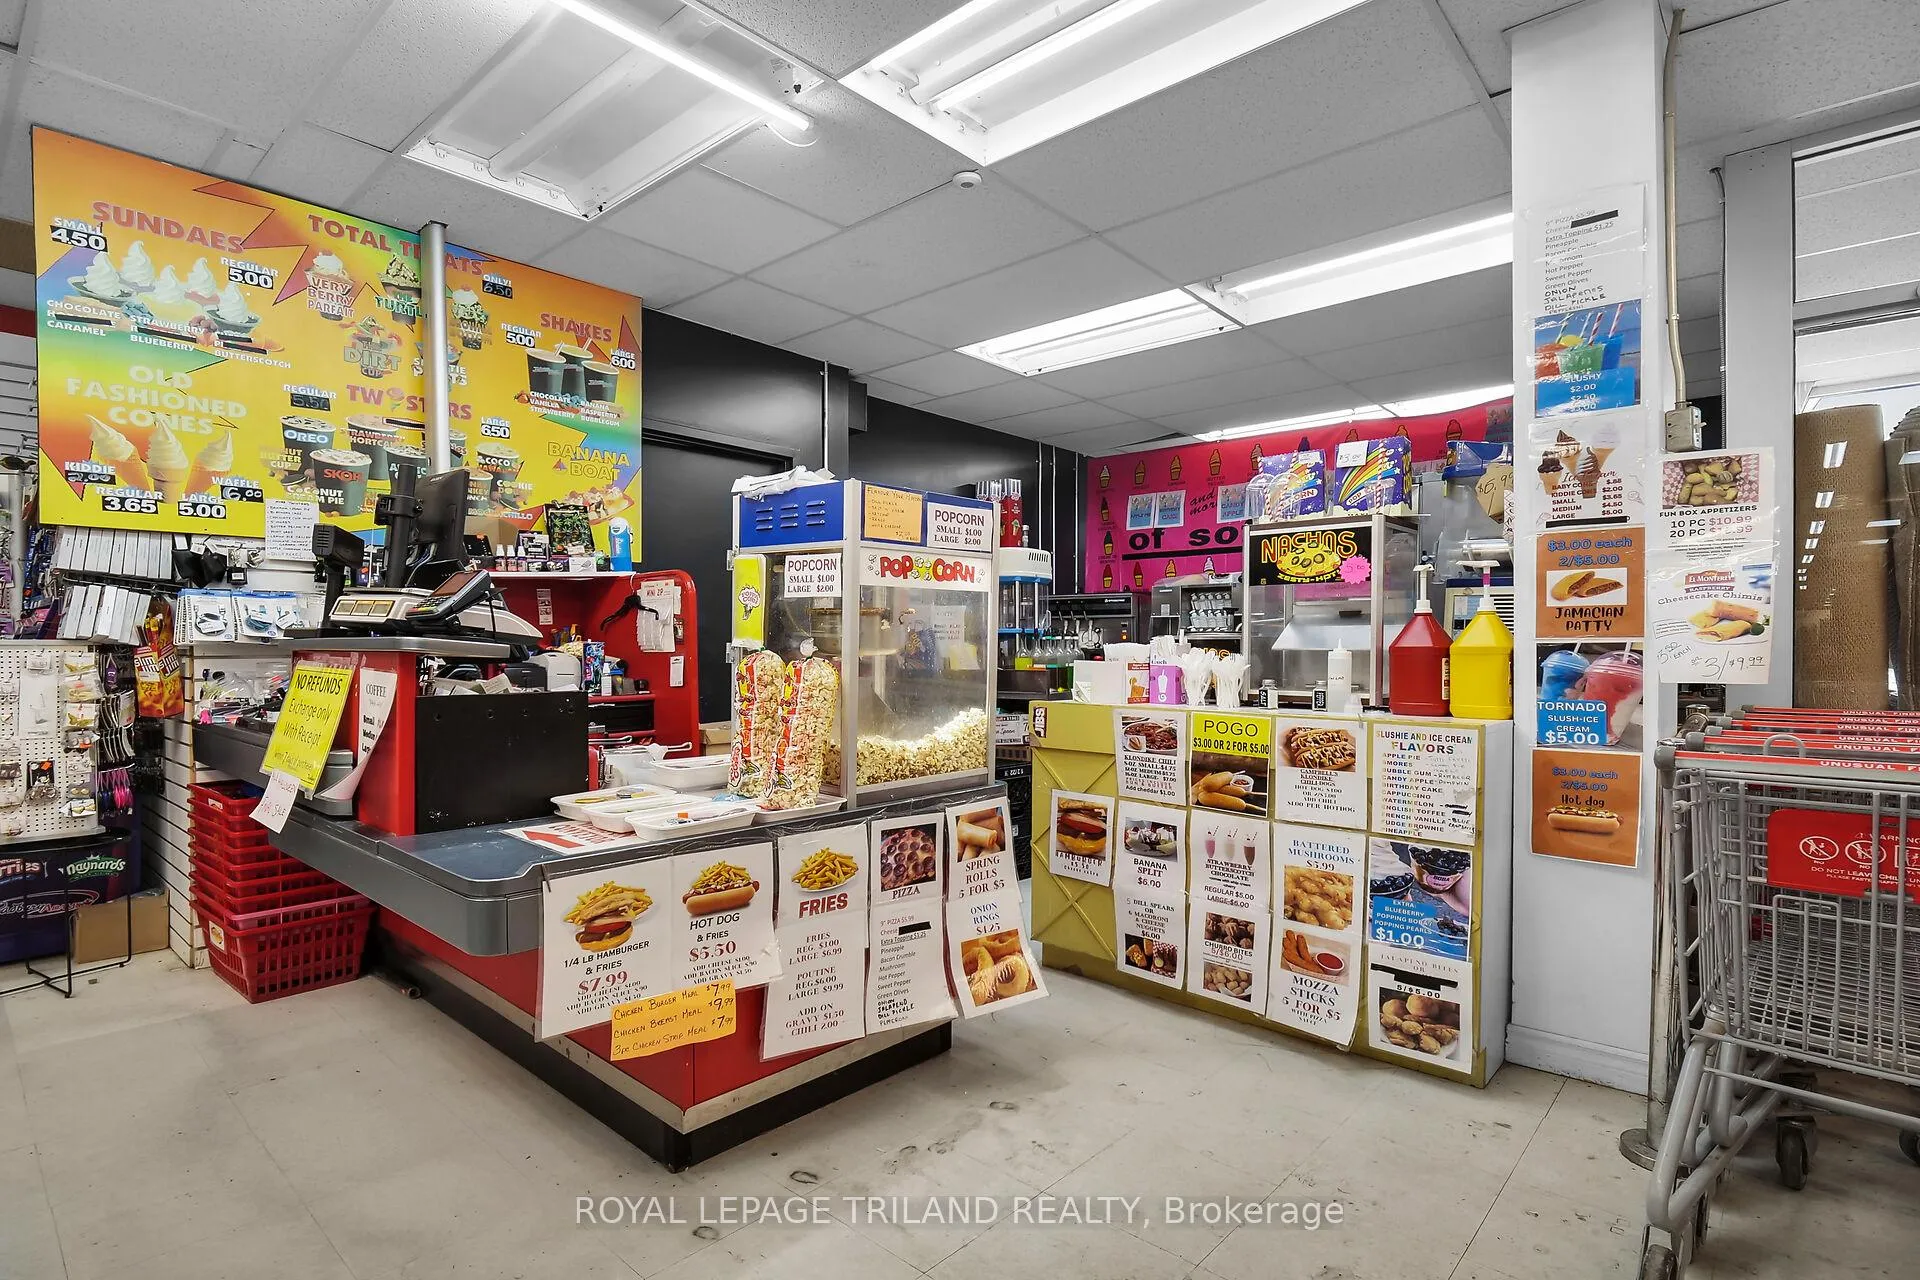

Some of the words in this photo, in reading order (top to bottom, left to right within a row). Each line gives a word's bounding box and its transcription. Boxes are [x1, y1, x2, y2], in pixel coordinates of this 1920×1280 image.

[92, 201, 244, 254] SUNDAES
[308, 214, 392, 251] TOTAL
[51, 228, 107, 251] 4.50
[221, 257, 278, 277] REGULAR
[312, 277, 352, 294] VERY
[1544, 286, 1577, 297] ONION
[308, 287, 354, 306] BERRY
[47, 299, 121, 320] CHOCOLATE
[47, 320, 106, 336] CARAMEL
[130, 314, 206, 334] STRAWBERRY
[540, 313, 612, 342] SHAKES
[130, 334, 194, 352] BLUEBERRY
[214, 349, 291, 369] BUTTERSCOTCH
[344, 346, 401, 371] DIRT
[129, 365, 193, 389] OLD
[1565, 373, 1602, 384] SLUSHY
[66, 378, 247, 418] FASHIONED
[283, 384, 336, 399] REGULAR
[108, 406, 213, 435] CONES
[480, 416, 511, 427] LARGE
[284, 429, 329, 444] OREO
[547, 441, 630, 467] BANANA
[64, 461, 116, 475] KIDDIE
[570, 461, 620, 481] BOAT
[212, 476, 260, 489] WAFFLE
[96, 485, 163, 500] REGULAR
[104, 497, 157, 513] 3.65
[179, 503, 226, 518] 5.00
[1601, 508, 1623, 516] $5.00
[1659, 508, 1677, 518] FUN
[1679, 508, 1698, 516] BOX
[1700, 504, 1758, 515] APPETIZERS
[934, 509, 985, 527] POPCORN
[1671, 519, 1686, 528] 10
[1688, 518, 1706, 527] PC
[1708, 515, 1753, 526] $10.99
[936, 525, 963, 535] SMALL
[965, 527, 983, 537] $1.00
[1128, 527, 1164, 550] of
[1669, 529, 1686, 538] 20
[1688, 527, 1706, 537] PC
[934, 534, 960, 543] LARGE
[964, 537, 981, 546] $2.00
[1261, 531, 1357, 563] NACHOS
[1547, 538, 1591, 552] $3.00
[1595, 537, 1632, 549] each
[787, 557, 837, 572] POPCORN
[1559, 553, 1620, 567] 2/$5.00
[879, 554, 915, 579] POP
[931, 557, 975, 583] CORN
[788, 574, 814, 583] SMALL
[817, 573, 835, 583] $1.00
[787, 584, 811, 593] LARGE
[816, 584, 834, 593] $2.00
[1658, 592, 1720, 605] Cheesecake
[1722, 592, 1763, 602] Chimis
[1555, 607, 1624, 619] JAMACIAN
[1565, 619, 1613, 632] PATTY
[134, 655, 157, 668] slim
[159, 655, 178, 670] slim
[295, 673, 306, 689] NO
[307, 675, 343, 696] REFUNDS
[365, 683, 387, 698] COFFEE
[288, 698, 318, 718] Exchange
[316, 706, 331, 724] only
[1537, 701, 1607, 712] TORNADO
[1547, 714, 1599, 723] SLUSH-ICE
[1204, 719, 1258, 737] POGO
[1556, 725, 1590, 733] CREAM
[298, 725, 321, 749] Receipt
[1545, 730, 1600, 745] $5.00
[1193, 737, 1212, 748] $3.00
[1213, 739, 1224, 750] OR
[1226, 740, 1231, 750] 2
[1232, 741, 1248, 752] FOR
[1249, 743, 1269, 755] $5.00
[1391, 741, 1454, 755] FLAVORS
[1833, 744, 1900, 752] UNUSUAL
[1820, 760, 1896, 770] UNUSUAL
[1137, 786, 1159, 794] cheddar
[1561, 794, 1582, 805] Hot
[1585, 795, 1605, 808] dog
[1293, 839, 1350, 854] BATTERED
[1288, 847, 1355, 864] MUSHROOMS
[965, 855, 1000, 872] SPRING
[1133, 858, 1168, 871] BANANA
[1205, 863, 1255, 877] BUTTERSCOTCH
[1207, 858, 1252, 871] STRAWBERRY
[1306, 859, 1335, 871] $5.99
[1826, 867, 1844, 875] NOT
[966, 868, 997, 884] ROLLS
[1137, 865, 1163, 878] SPLIT
[1210, 870, 1249, 882] CHOCOLATE
[958, 889, 965, 898] 5
[969, 882, 989, 895] FOR
[993, 879, 1005, 891] $5
[1137, 877, 1162, 888] $6.00
[892, 886, 920, 900] PIZZA
[1204, 885, 1234, 897] REGULAR
[1235, 889, 1255, 901] $5.00
[799, 892, 848, 919] FRIES
[970, 901, 997, 915] ONION
[1133, 899, 1149, 908] DILL
[1150, 901, 1175, 912] SPEARS
[1384, 905, 1425, 917] BLUEBERRY
[690, 918, 714, 931] HOT
[716, 912, 740, 925] DOG
[973, 913, 1000, 925] RINGS
[1376, 912, 1406, 922] POPPING
[696, 933, 704, 943] &
[706, 930, 729, 940] FRIES
[1375, 927, 1425, 948] $1.00
[563, 957, 580, 969] 1/4
[582, 953, 594, 964] LB
[596, 940, 650, 960] HAMBURGER
[689, 940, 736, 962] $5.50
[1204, 940, 1234, 951] CHURRO
[1234, 947, 1253, 958] BITES
[585, 966, 594, 975] &
[596, 959, 622, 973] FRIES
[796, 966, 836, 981] POUTINE
[578, 970, 628, 995] $7.99
[893, 977, 911, 989] Pepper
[1292, 975, 1339, 995] MOZZA
[1290, 986, 1335, 1006] STICKS
[1282, 997, 1289, 1005] 5
[1296, 1000, 1320, 1015] FOR
[1326, 1007, 1341, 1021] $5
[785, 1014, 821, 1029] GRAVY
